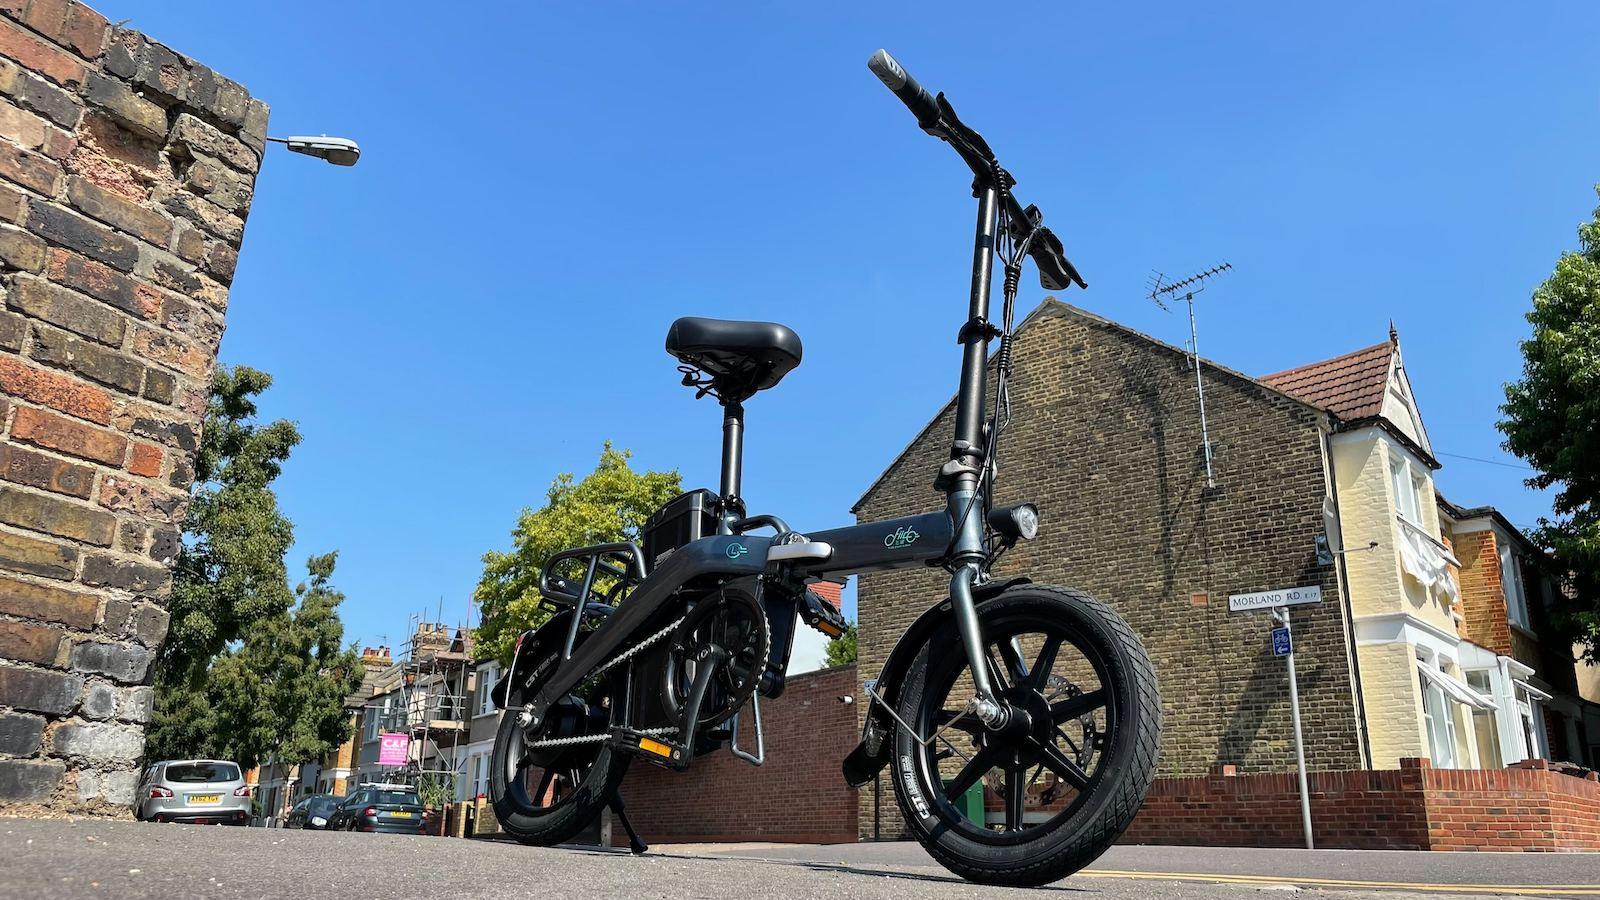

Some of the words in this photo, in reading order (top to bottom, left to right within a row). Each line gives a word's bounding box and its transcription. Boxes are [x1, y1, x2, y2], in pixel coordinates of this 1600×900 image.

[1233, 594, 1282, 607] MORLAND
[525, 669, 539, 688] CST
[383, 738, 407, 749] C&F
[911, 796, 931, 820] CST
